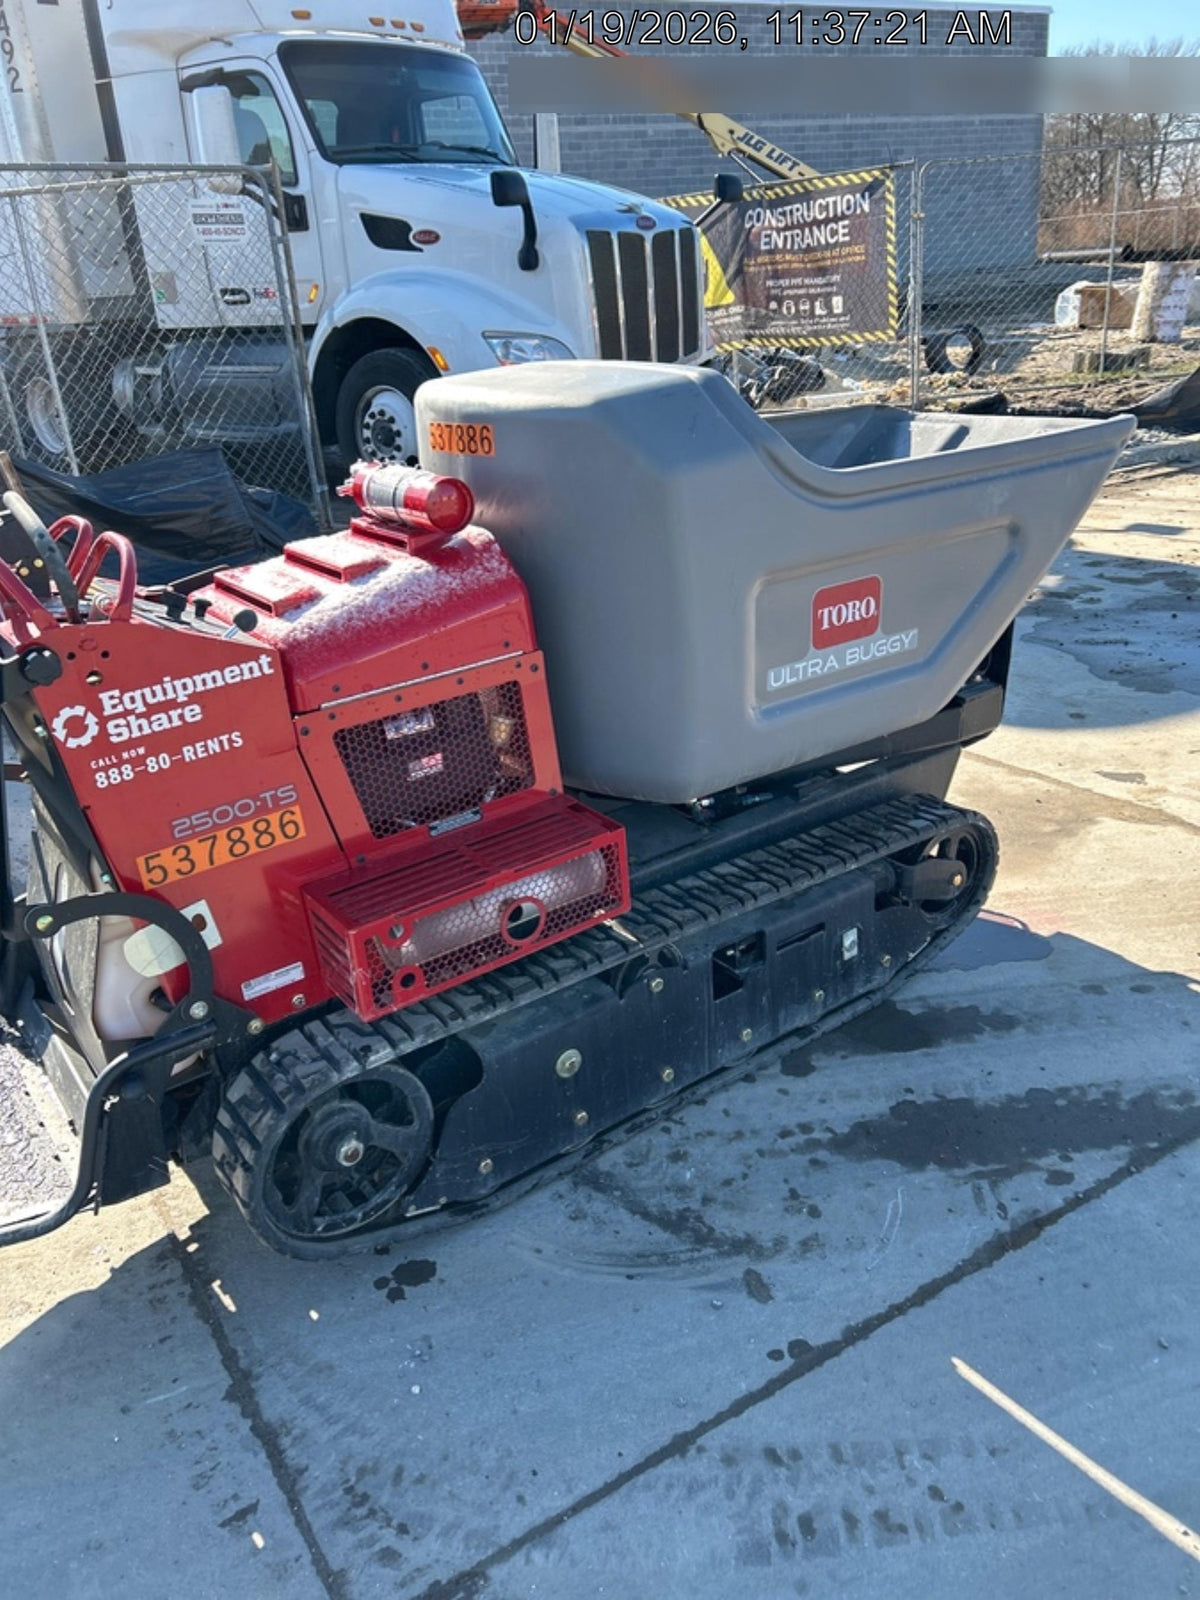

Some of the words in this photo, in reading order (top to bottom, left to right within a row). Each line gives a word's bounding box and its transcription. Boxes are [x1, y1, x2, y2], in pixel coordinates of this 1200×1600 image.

[736, 131, 767, 152] JLG
[766, 147, 800, 171] LIFT
[744, 191, 870, 229] CONSTRUCTION
[760, 220, 851, 250] ENTRANCE
[429, 422, 492, 455] 537886
[817, 596, 876, 630] TORO
[770, 655, 839, 687] ULTRA
[845, 632, 913, 665] BUGGY
[99, 653, 274, 716] Equipment
[106, 703, 203, 743] Share
[90, 754, 118, 769] CALL
[122, 746, 146, 760] NOW
[94, 731, 244, 789] 888-80-RENTS
[144, 809, 300, 886] 537886
